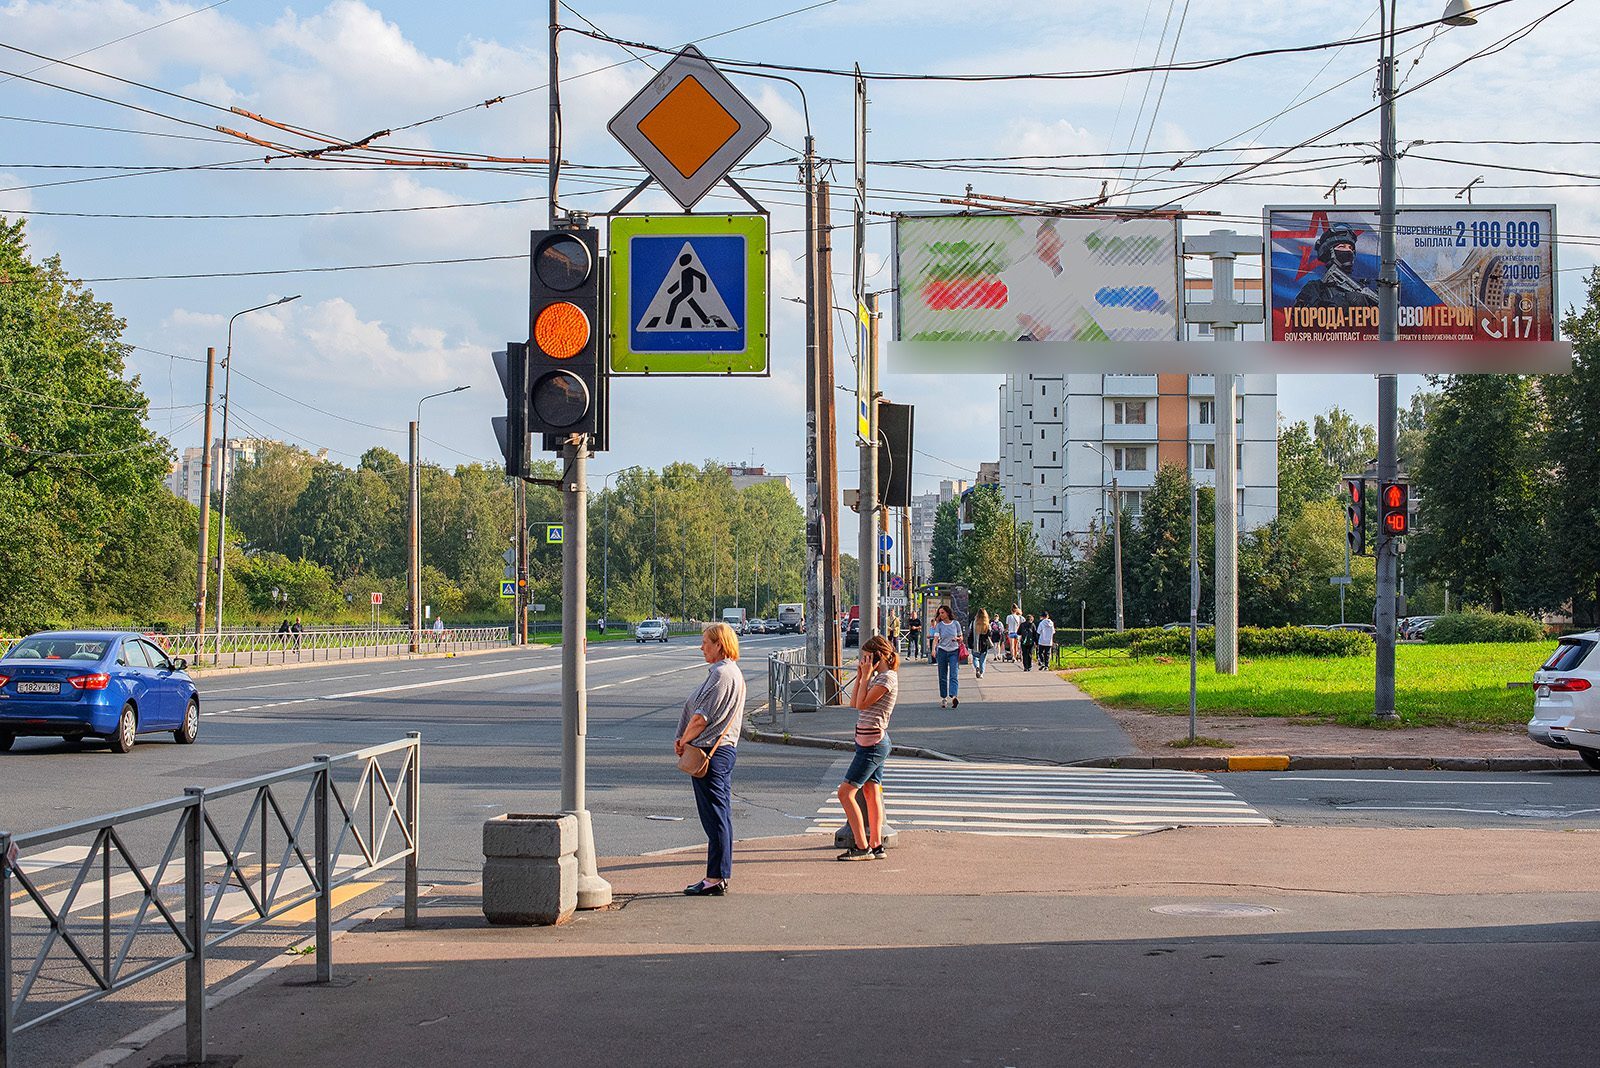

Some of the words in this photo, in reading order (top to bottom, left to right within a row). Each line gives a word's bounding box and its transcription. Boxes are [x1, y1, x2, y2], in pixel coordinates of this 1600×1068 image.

[1396, 225, 1453, 235] НОВРЕМЕННАЯ
[1456, 221, 1466, 247] 2
[1471, 221, 1501, 247] 100
[1506, 221, 1540, 247] 000
[1414, 237, 1453, 247] ВЫПЛАТА
[1502, 264, 1519, 279] 210
[1520, 264, 1540, 279] 000
[1283, 307, 1293, 327] У
[1294, 306, 1380, 329] ГОРОДА-ГЕРО
[1397, 306, 1433, 327] СВОИ
[1434, 306, 1474, 327] ГЕРОИ
[1501, 315, 1533, 339] 117
[1284, 332, 1360, 341] GOV.SPB.RU/CONTRACT
[1387, 514, 1405, 531] 40
